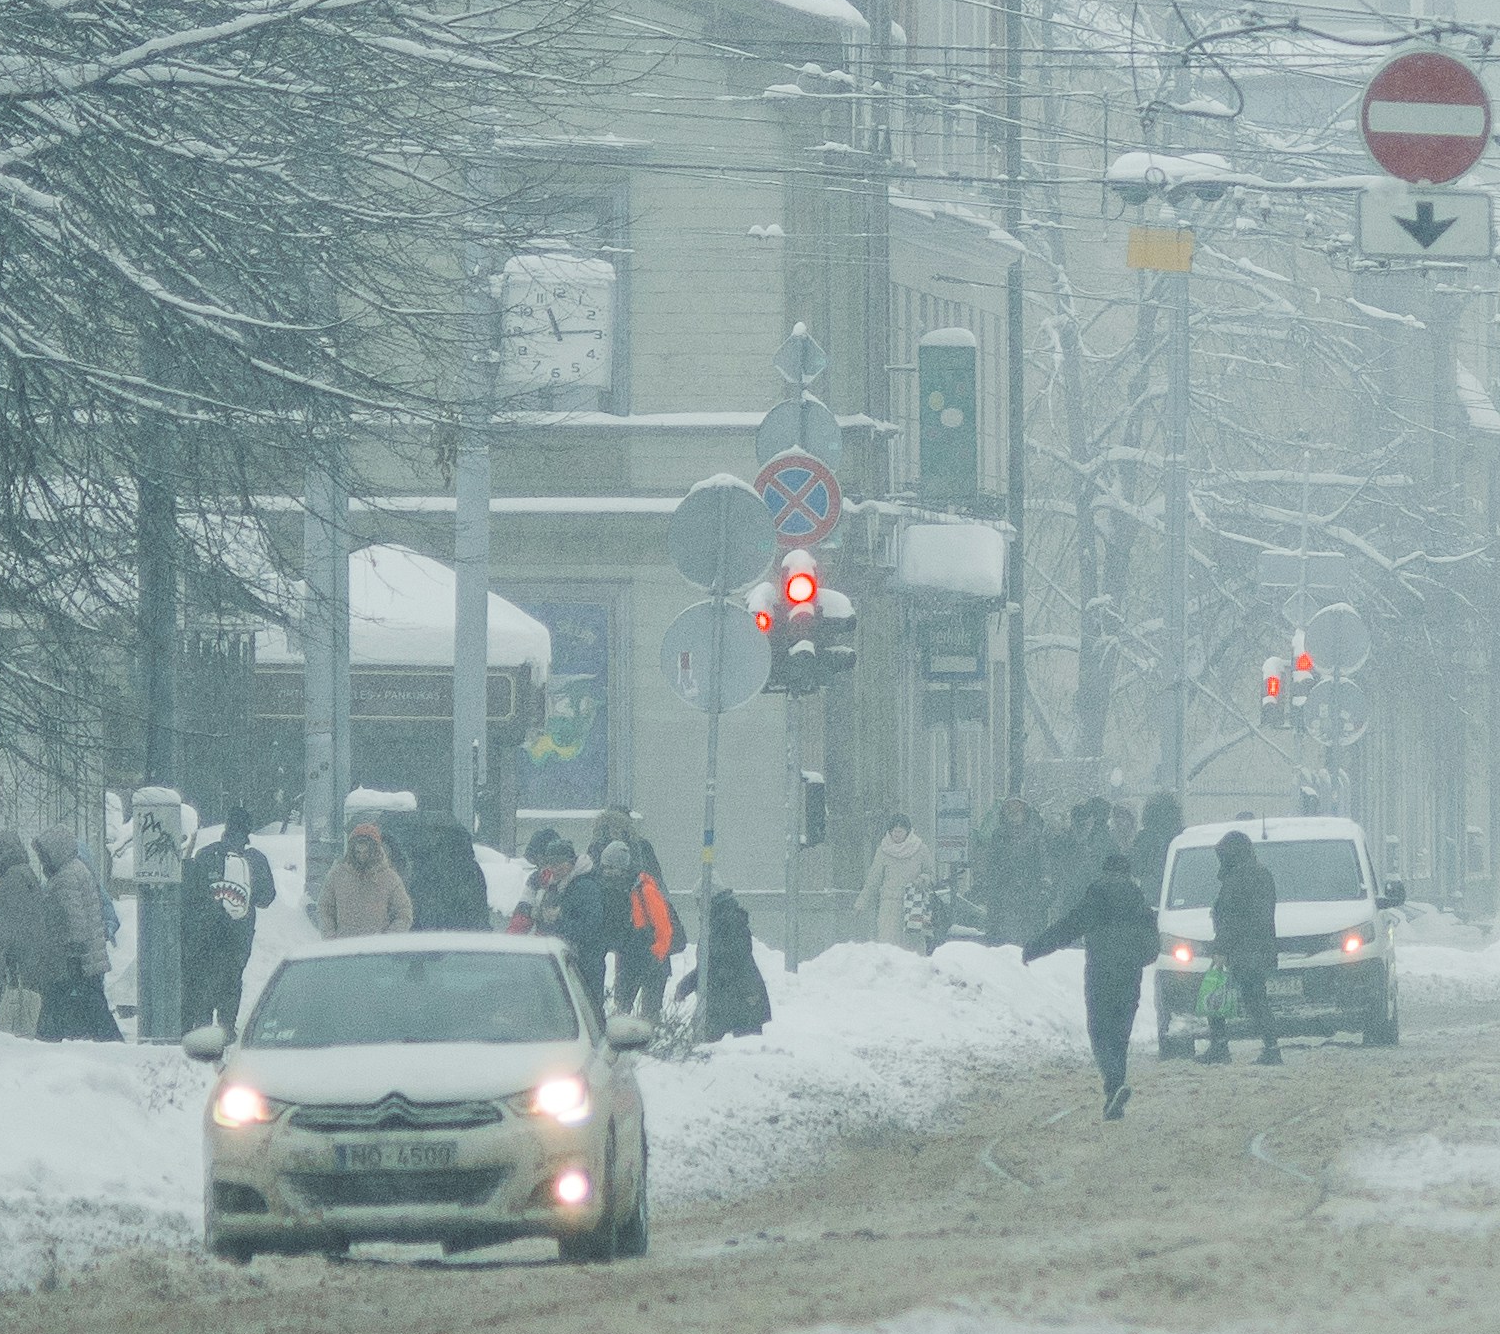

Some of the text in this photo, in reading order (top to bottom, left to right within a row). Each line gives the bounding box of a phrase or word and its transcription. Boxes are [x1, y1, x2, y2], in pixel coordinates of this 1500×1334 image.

[586, 310, 596, 321] 2
[586, 349, 596, 359] 4
[551, 367, 561, 379] 6
[571, 362, 581, 373] 5
